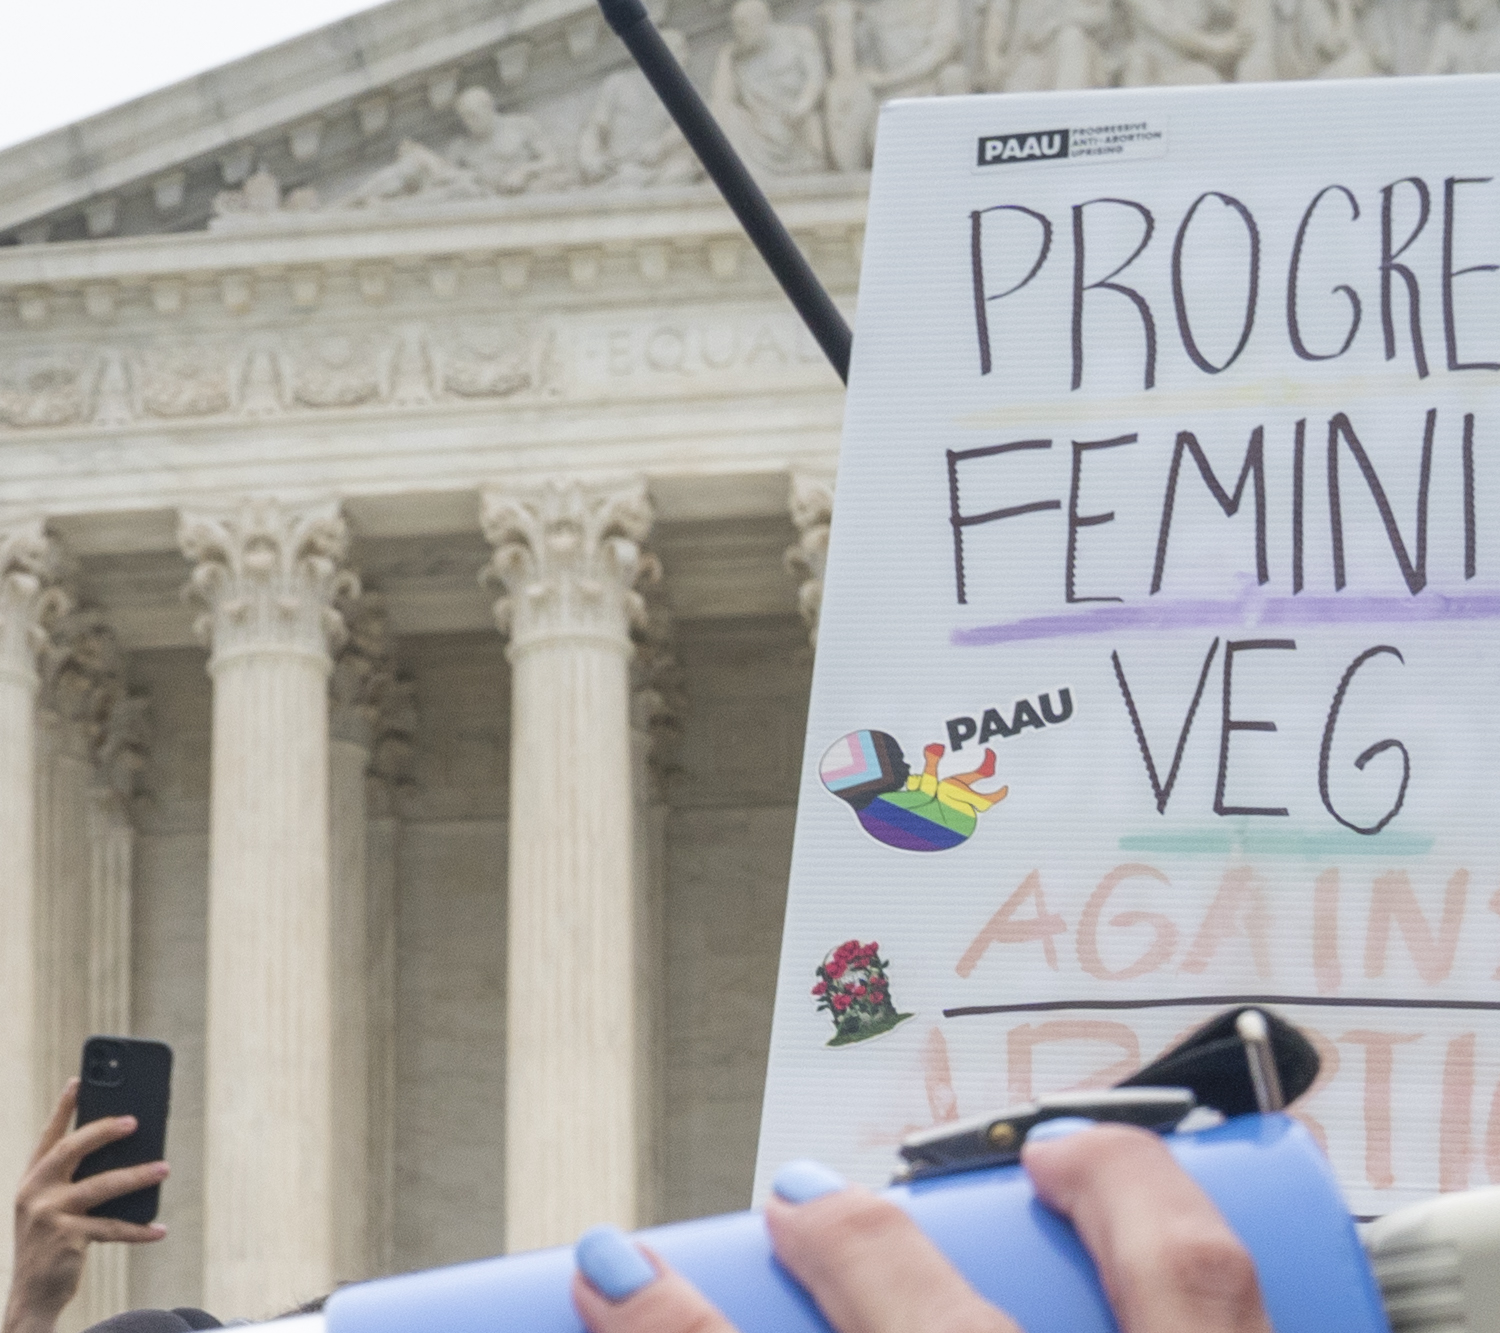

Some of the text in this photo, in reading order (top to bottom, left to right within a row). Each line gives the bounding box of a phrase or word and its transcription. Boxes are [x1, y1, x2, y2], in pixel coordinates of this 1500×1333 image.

[1071, 131, 1162, 147] ANTI-ABORTION
[1072, 122, 1147, 136] PROGRESSIVE
[984, 133, 1062, 161] PAAU
[946, 688, 1075, 753] PAAU
[1111, 636, 1411, 836] VEG
